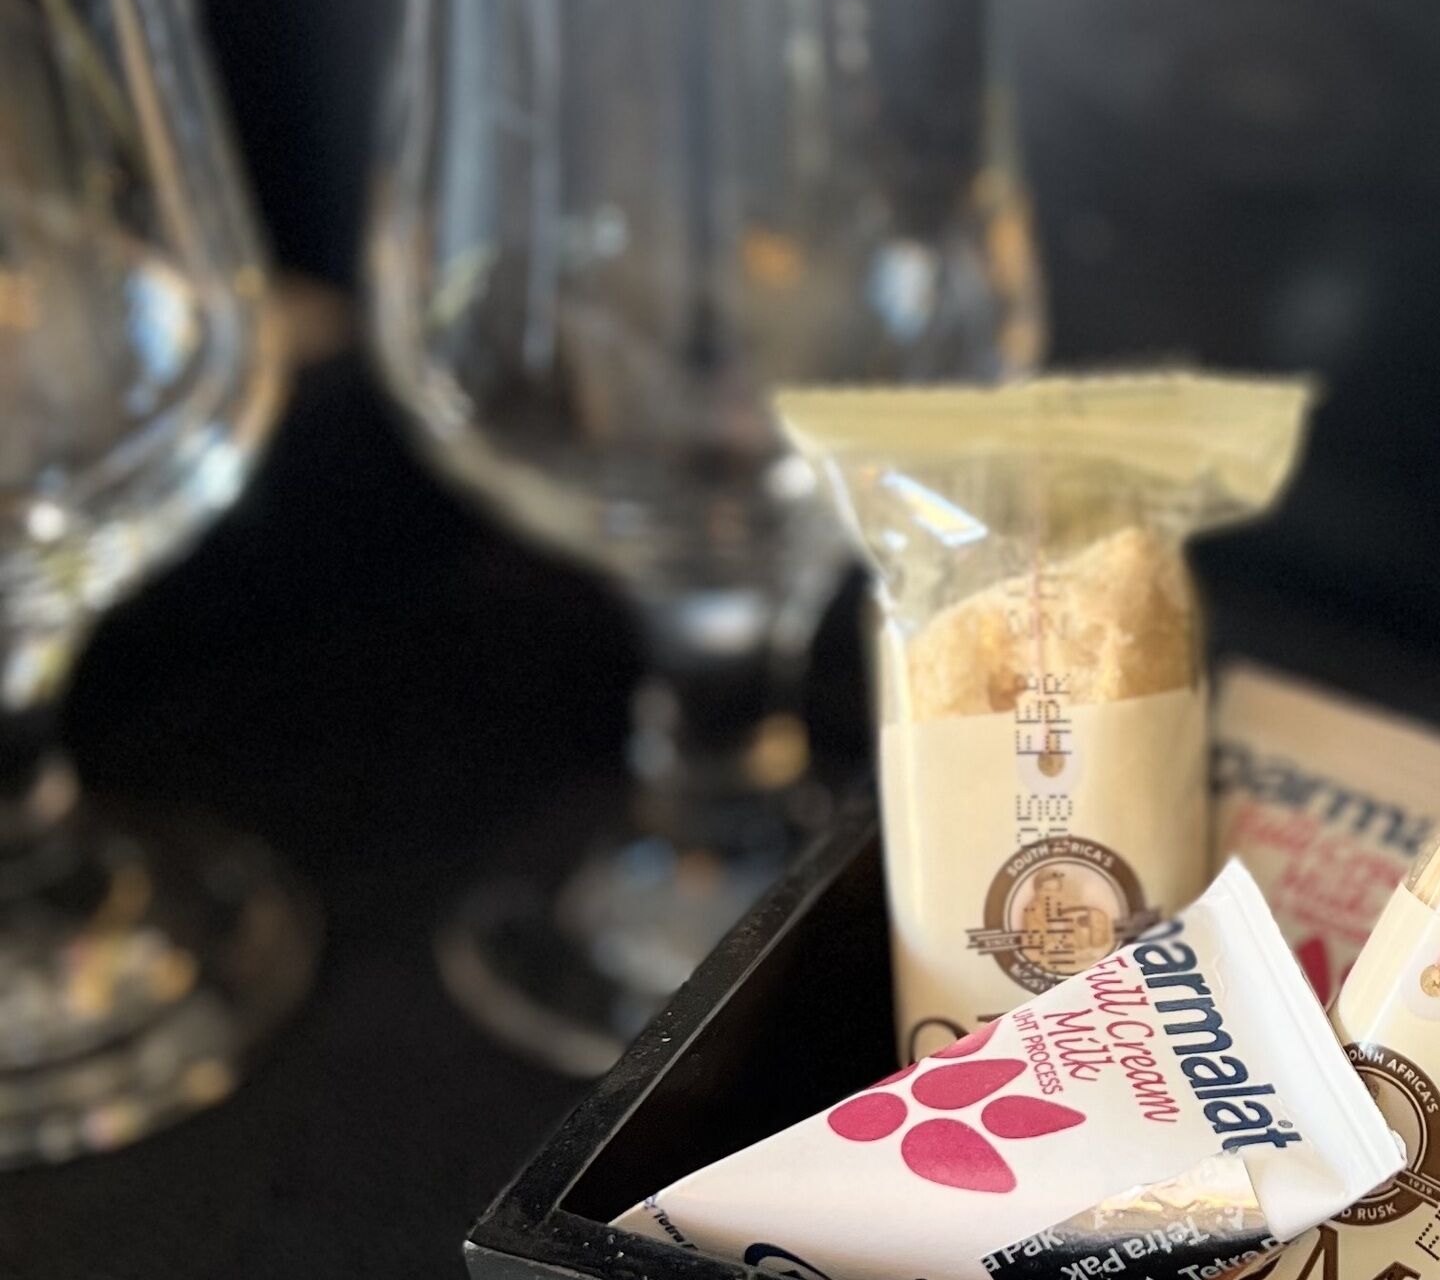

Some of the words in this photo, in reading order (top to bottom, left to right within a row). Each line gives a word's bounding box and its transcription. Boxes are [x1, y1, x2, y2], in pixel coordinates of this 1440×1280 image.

[1044, 672, 1074, 756] APR
[1005, 841, 1049, 878] SOUTH
[1085, 955, 1150, 1017] Full
[1012, 1008, 1039, 1032] UHT
[1044, 1008, 1115, 1082] Milk
[1022, 1034, 1064, 1095] PROCESS
[1105, 1020, 1180, 1124] Cream
[1348, 1047, 1385, 1067] OUTH
[1386, 1057, 1439, 1115] AFRICA'S
[1121, 1216, 1210, 1260] Tetra
[1357, 1203, 1398, 1221] RUSK
[1001, 1225, 1067, 1265] Pak
